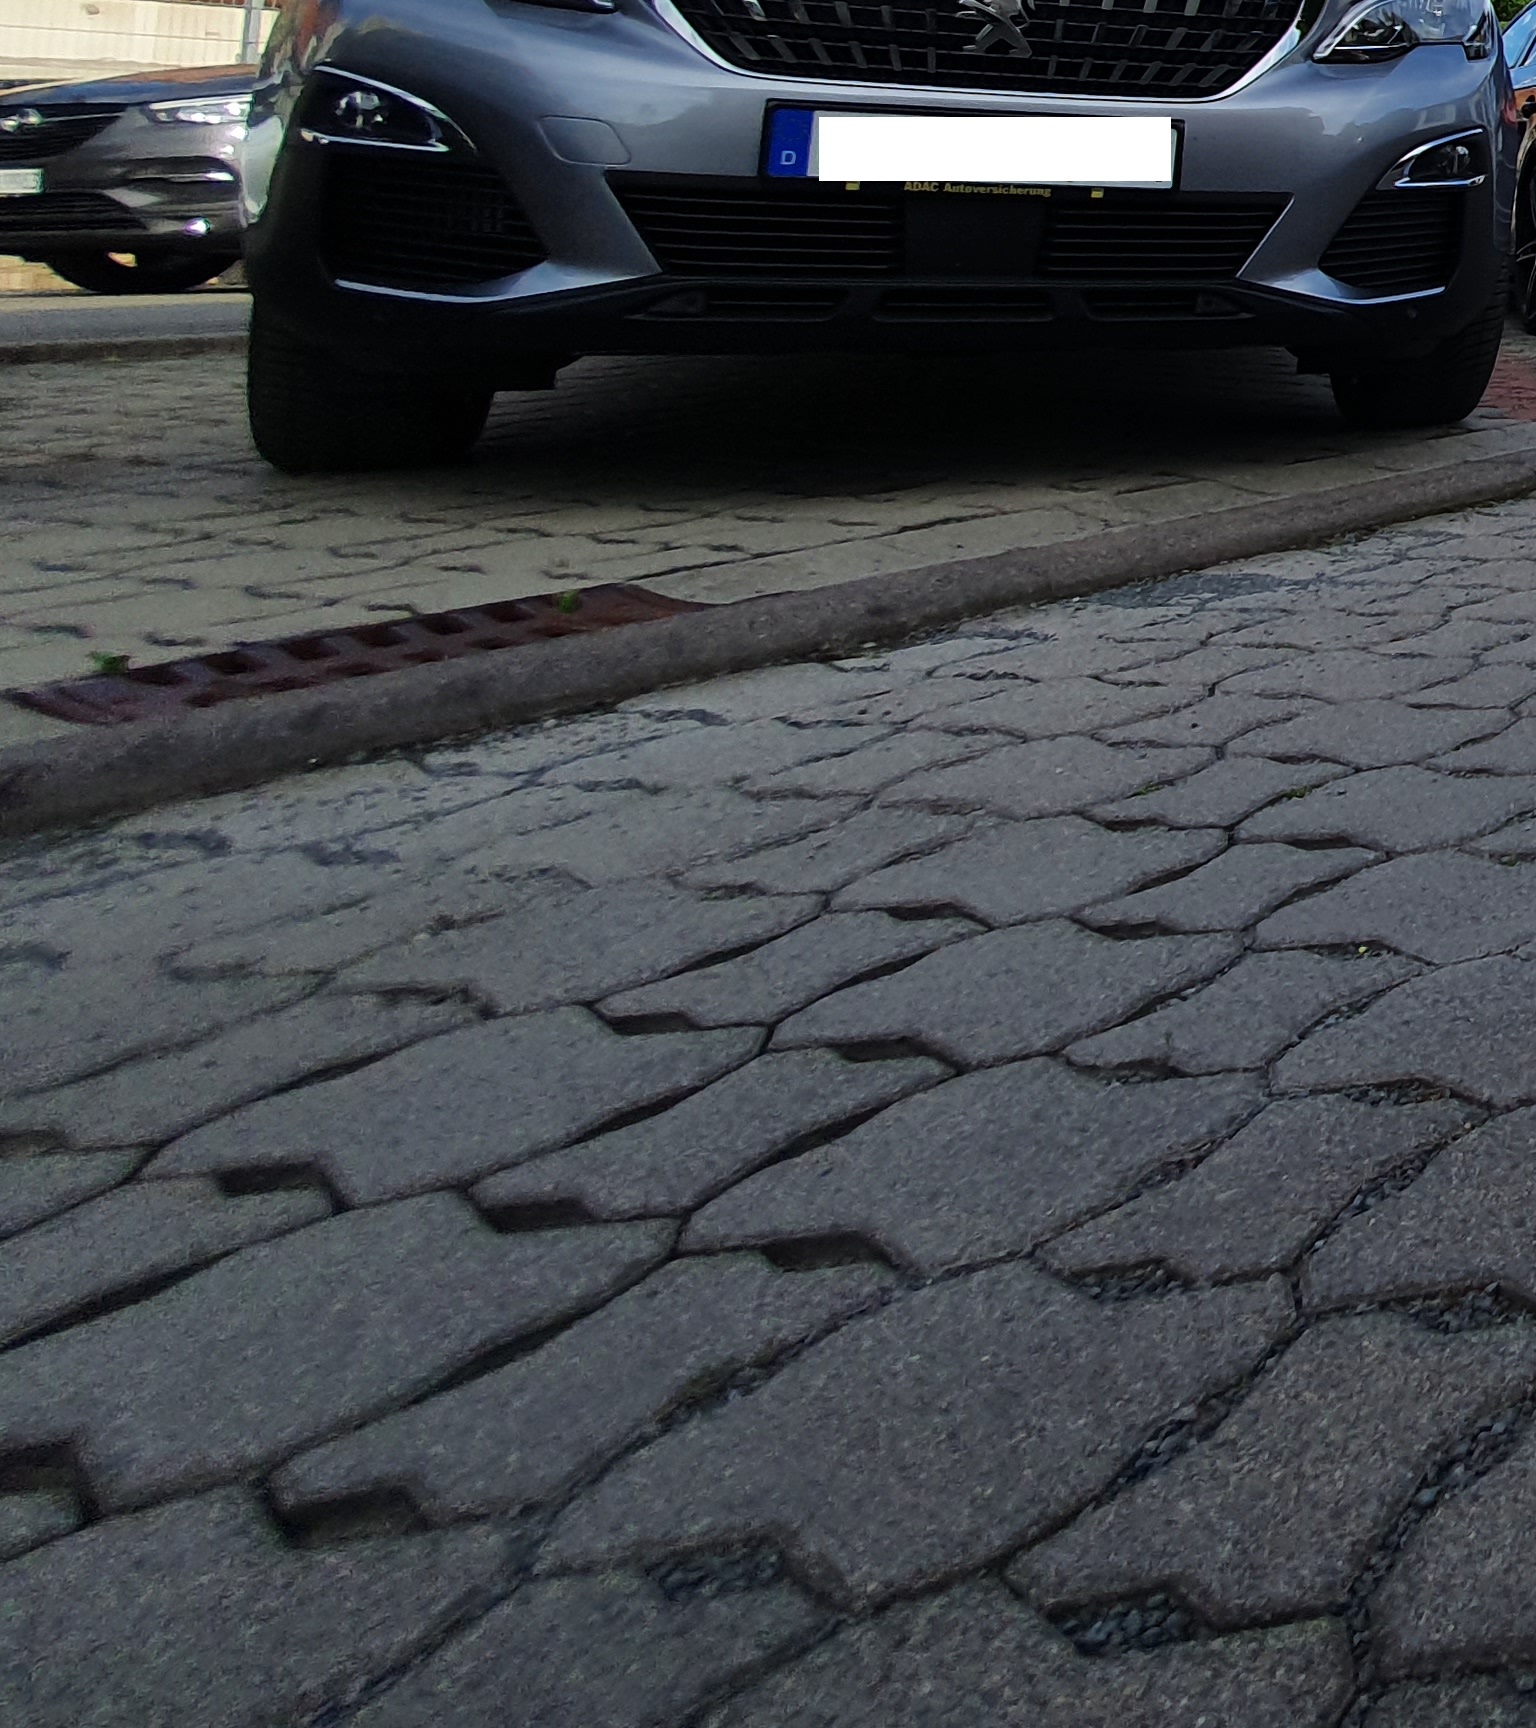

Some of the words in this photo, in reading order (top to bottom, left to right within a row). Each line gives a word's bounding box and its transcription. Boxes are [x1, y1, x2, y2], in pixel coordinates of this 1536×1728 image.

[780, 150, 796, 165] D
[904, 181, 939, 192] ADAC
[943, 182, 1051, 198] Autoversicherung
